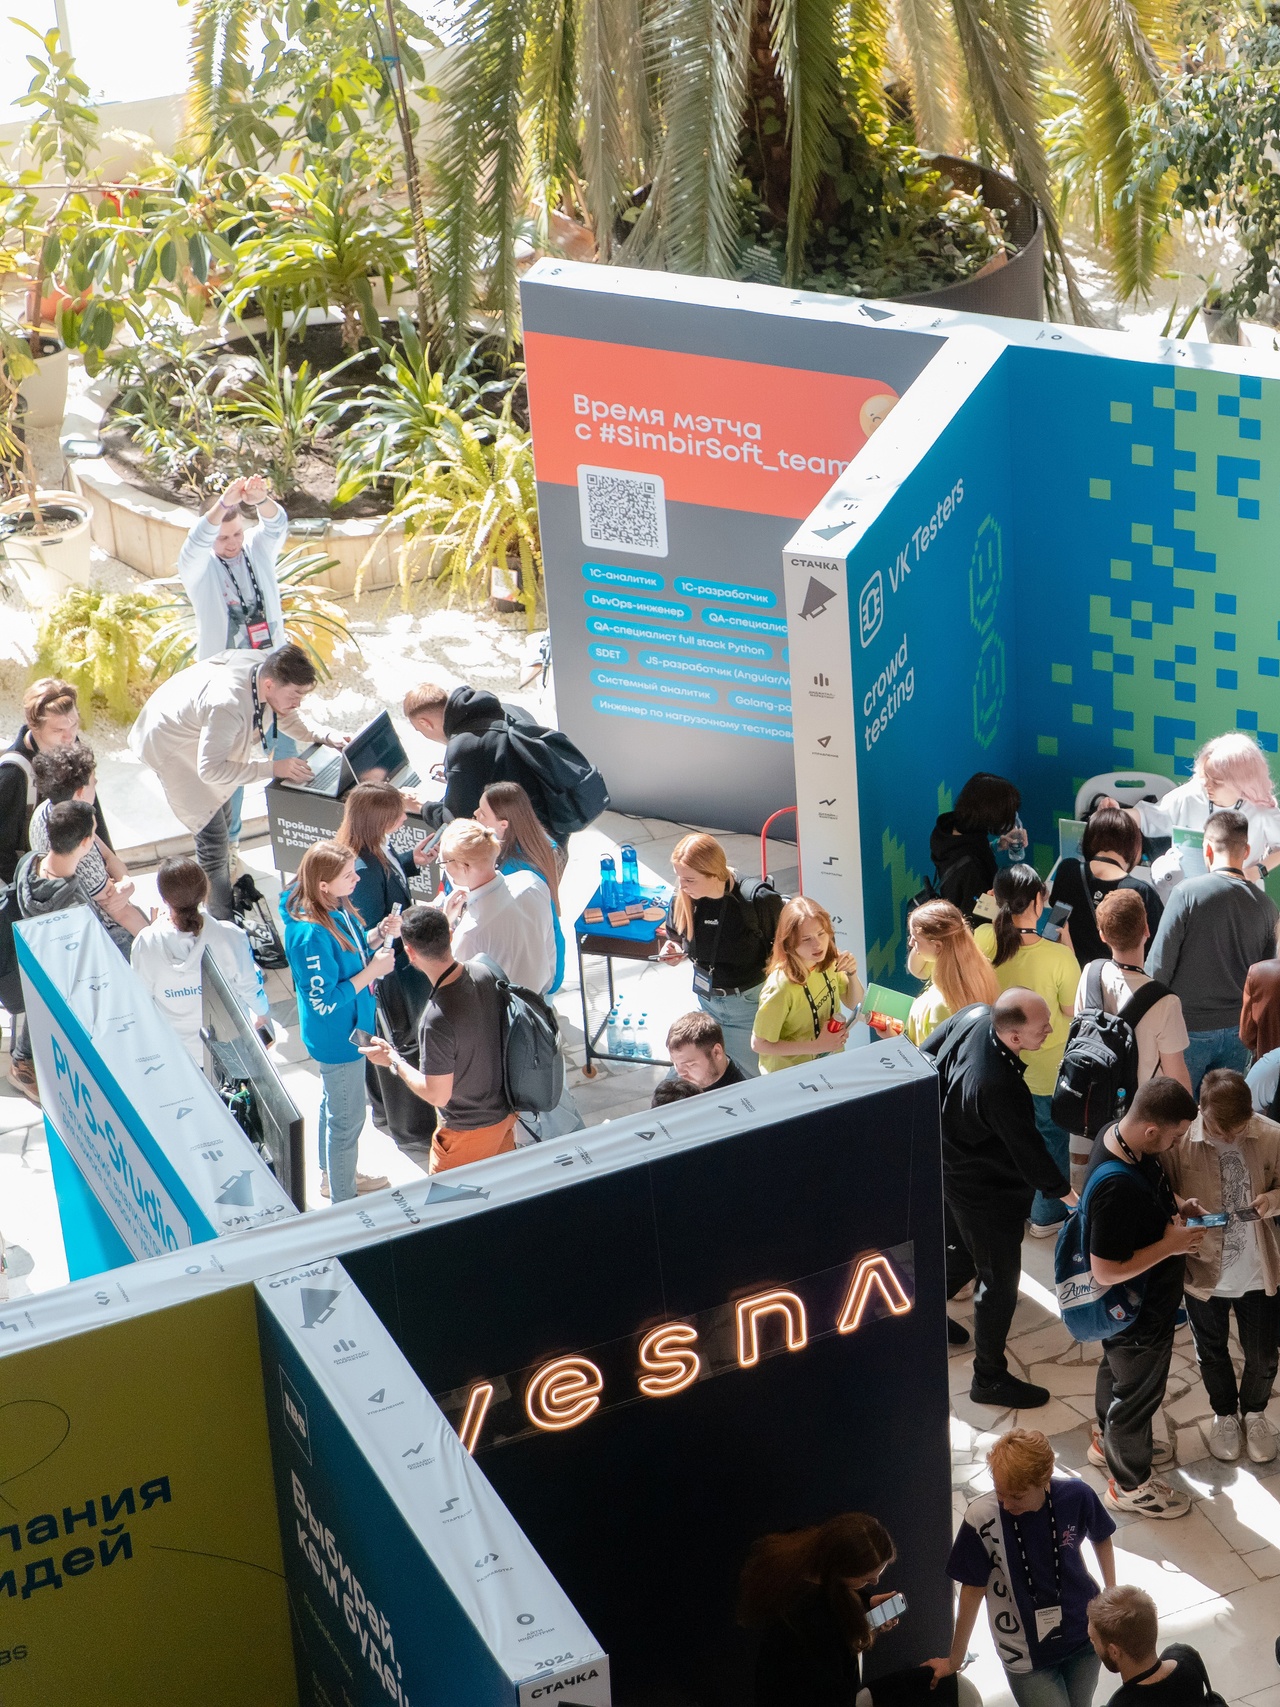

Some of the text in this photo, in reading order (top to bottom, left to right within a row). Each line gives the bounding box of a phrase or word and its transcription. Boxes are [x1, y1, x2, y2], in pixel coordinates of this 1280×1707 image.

[573, 393, 762, 441] Время мэтча
[889, 478, 964, 593] VK Testers
[791, 558, 840, 571] СТАЧКА
[591, 594, 685, 618] DevOps-инженер
[593, 621, 766, 657] QA-специалист full stack Python
[595, 648, 791, 687] SDET JS-разработчик (Angular/V
[863, 633, 909, 718] crowd
[597, 673, 659, 692] Системный
[660, 684, 711, 700] аналитик
[599, 700, 649, 717] Инженер
[649, 709, 664, 719] по
[665, 711, 740, 732] нагрузочному
[864, 667, 916, 752] testing
[277, 817, 319, 833] Пройди
[306, 955, 321, 971] IT
[51, 1033, 179, 1252] PVS-Studio
[355, 1210, 376, 1229] 2024
[391, 1189, 421, 1225] СТАЧКА
[269, 1266, 333, 1289] СТАЧКА
[284, 1391, 307, 1439] IBS
[367, 1400, 405, 1415] УПРАВЛЕНИЕ
[291, 1469, 403, 1680] Выбирай,
[296, 1519, 339, 1608] кем
[534, 1651, 575, 1671] 2024
[530, 1669, 600, 1700] СТАЧКА
